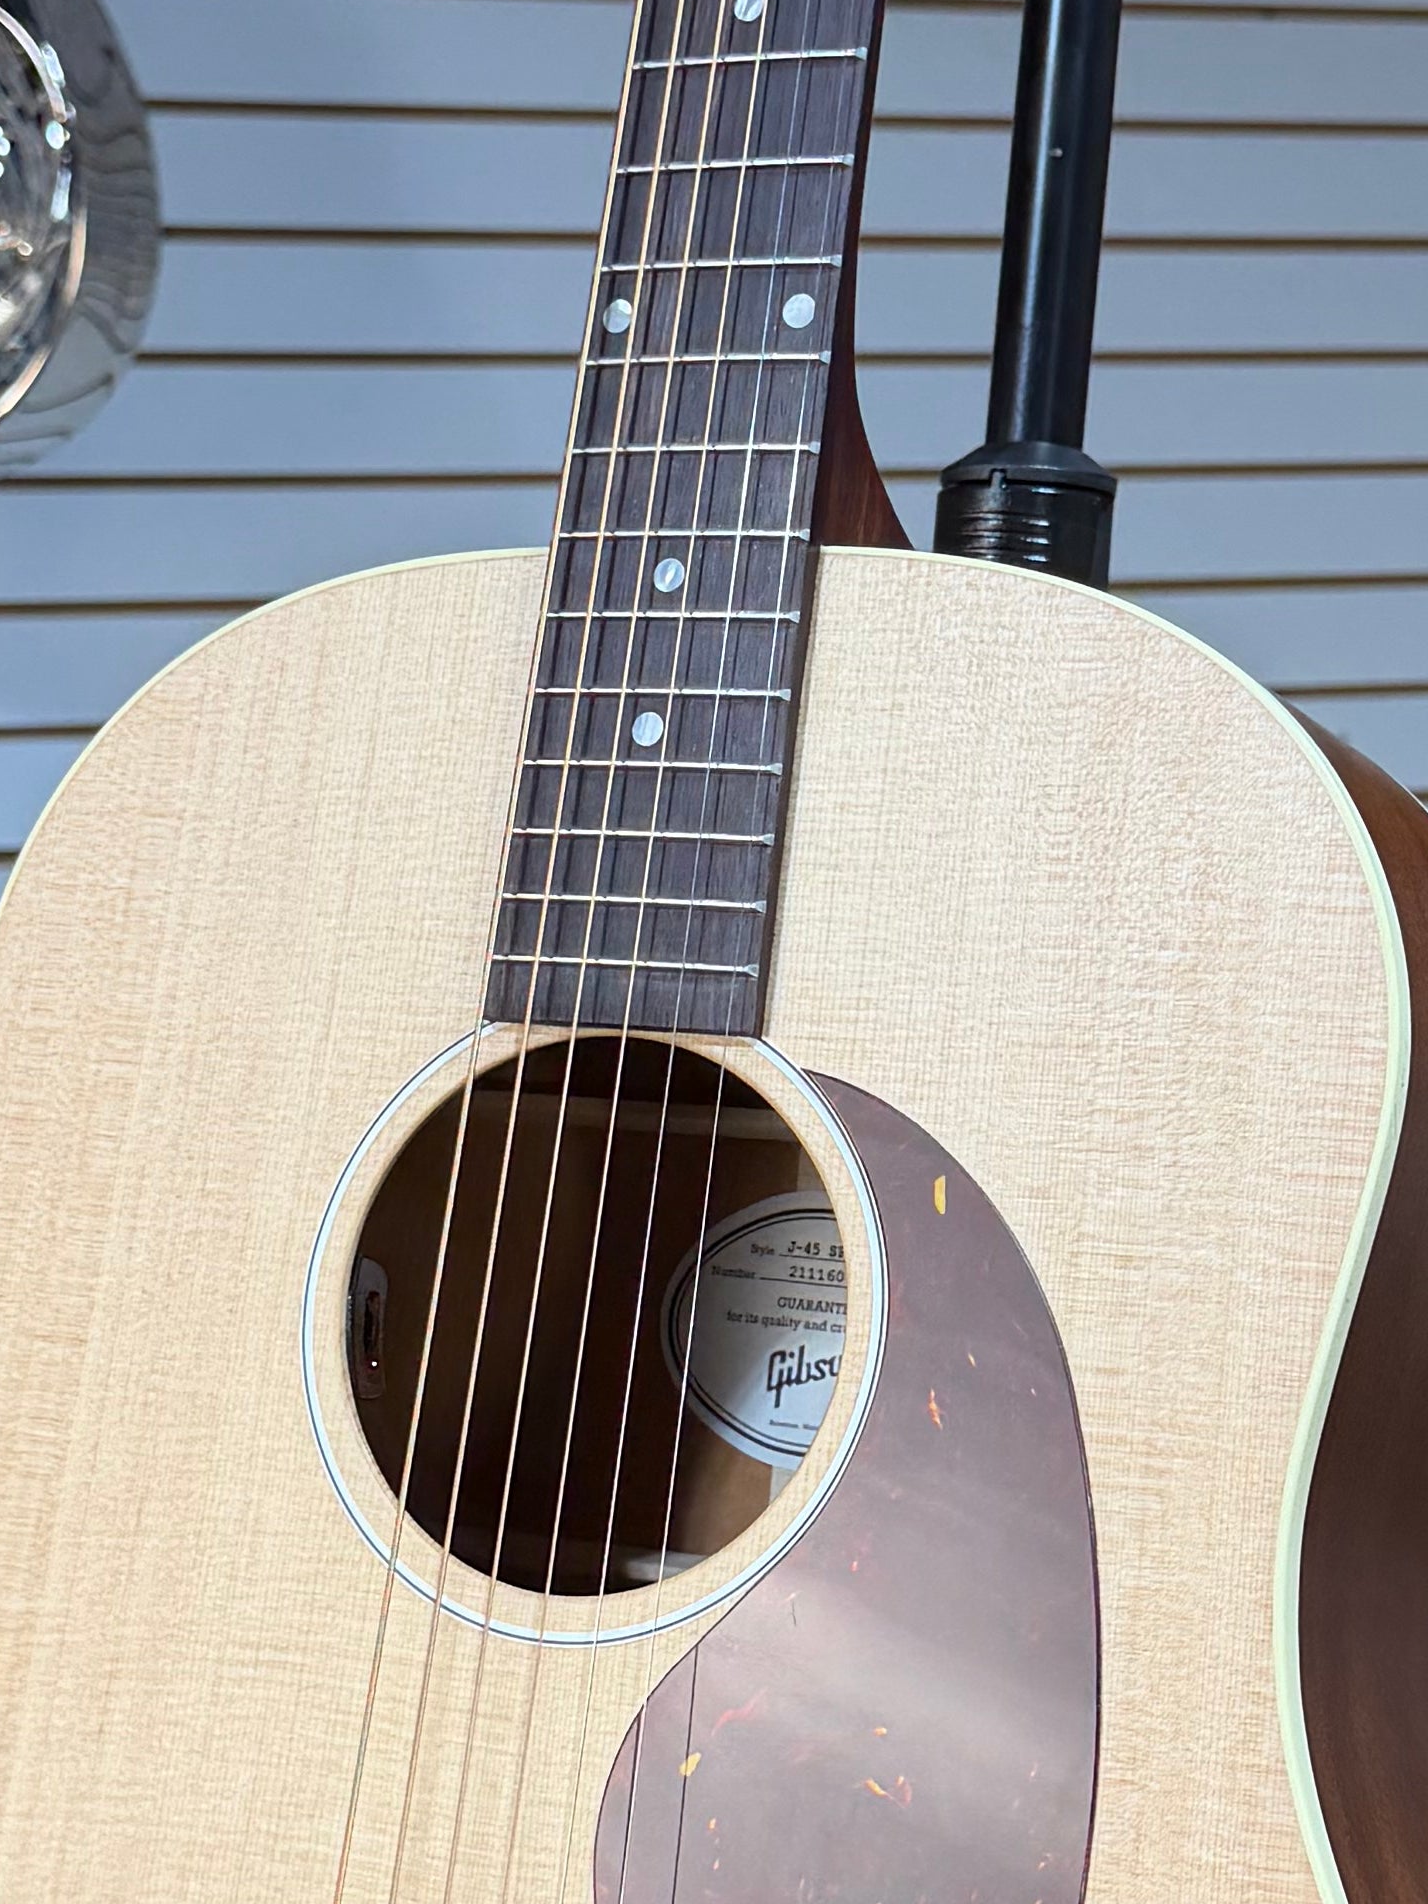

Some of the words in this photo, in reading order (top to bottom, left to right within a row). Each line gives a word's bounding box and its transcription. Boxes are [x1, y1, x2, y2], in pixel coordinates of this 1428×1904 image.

[787, 1241, 821, 1256] J-45
[762, 1314, 801, 1332] quality
[804, 1319, 828, 1333] and
